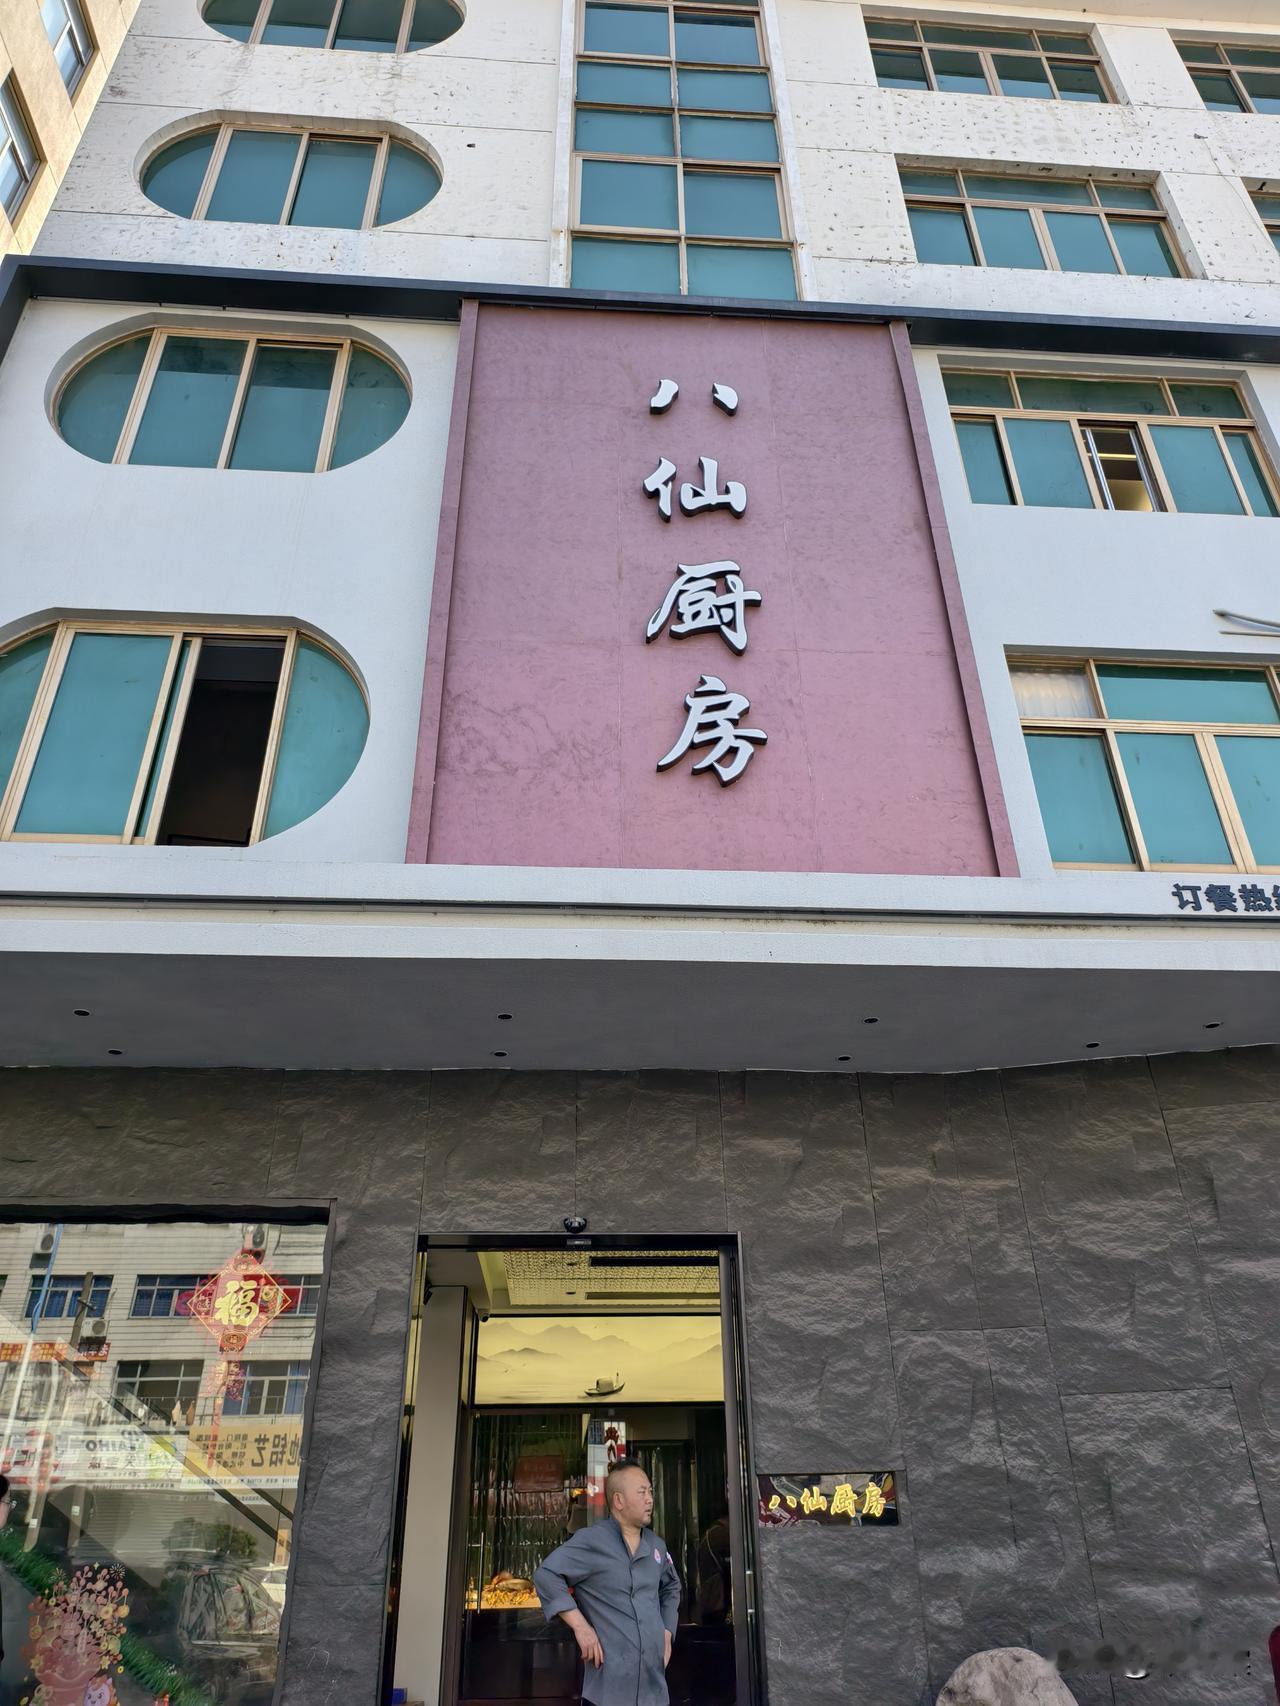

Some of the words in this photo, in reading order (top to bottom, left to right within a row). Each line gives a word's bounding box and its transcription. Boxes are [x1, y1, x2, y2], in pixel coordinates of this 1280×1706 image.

[642, 379, 768, 788] 八仙厨房
[214, 1280, 260, 1327] 福
[768, 1481, 887, 1518] 八仙厨房
